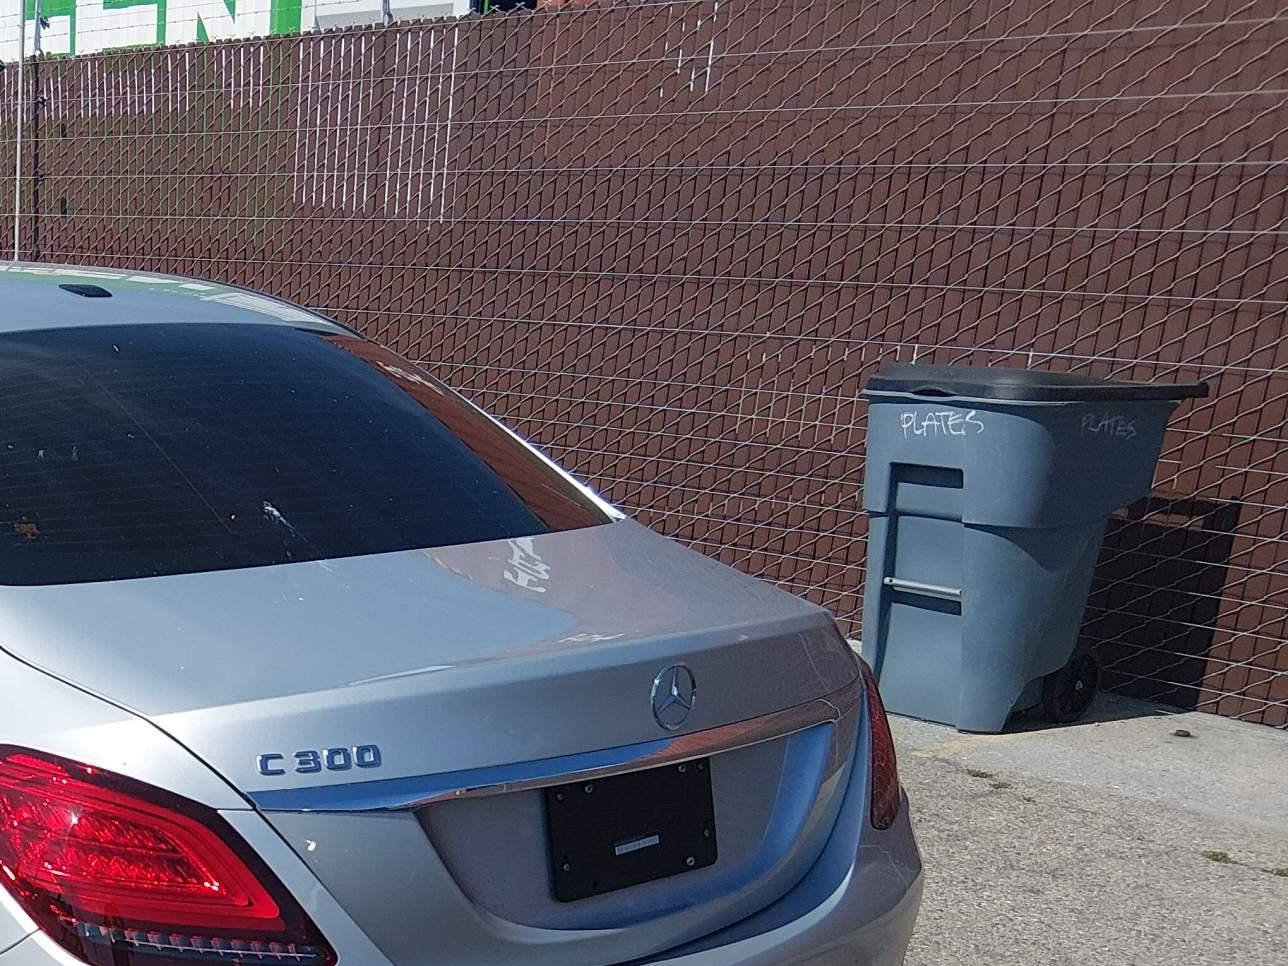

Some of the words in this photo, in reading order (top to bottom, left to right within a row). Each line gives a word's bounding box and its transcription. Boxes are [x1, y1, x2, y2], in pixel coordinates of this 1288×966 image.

[900, 410, 985, 439] PLATES
[256, 753, 286, 776] C
[294, 745, 382, 774] 300
